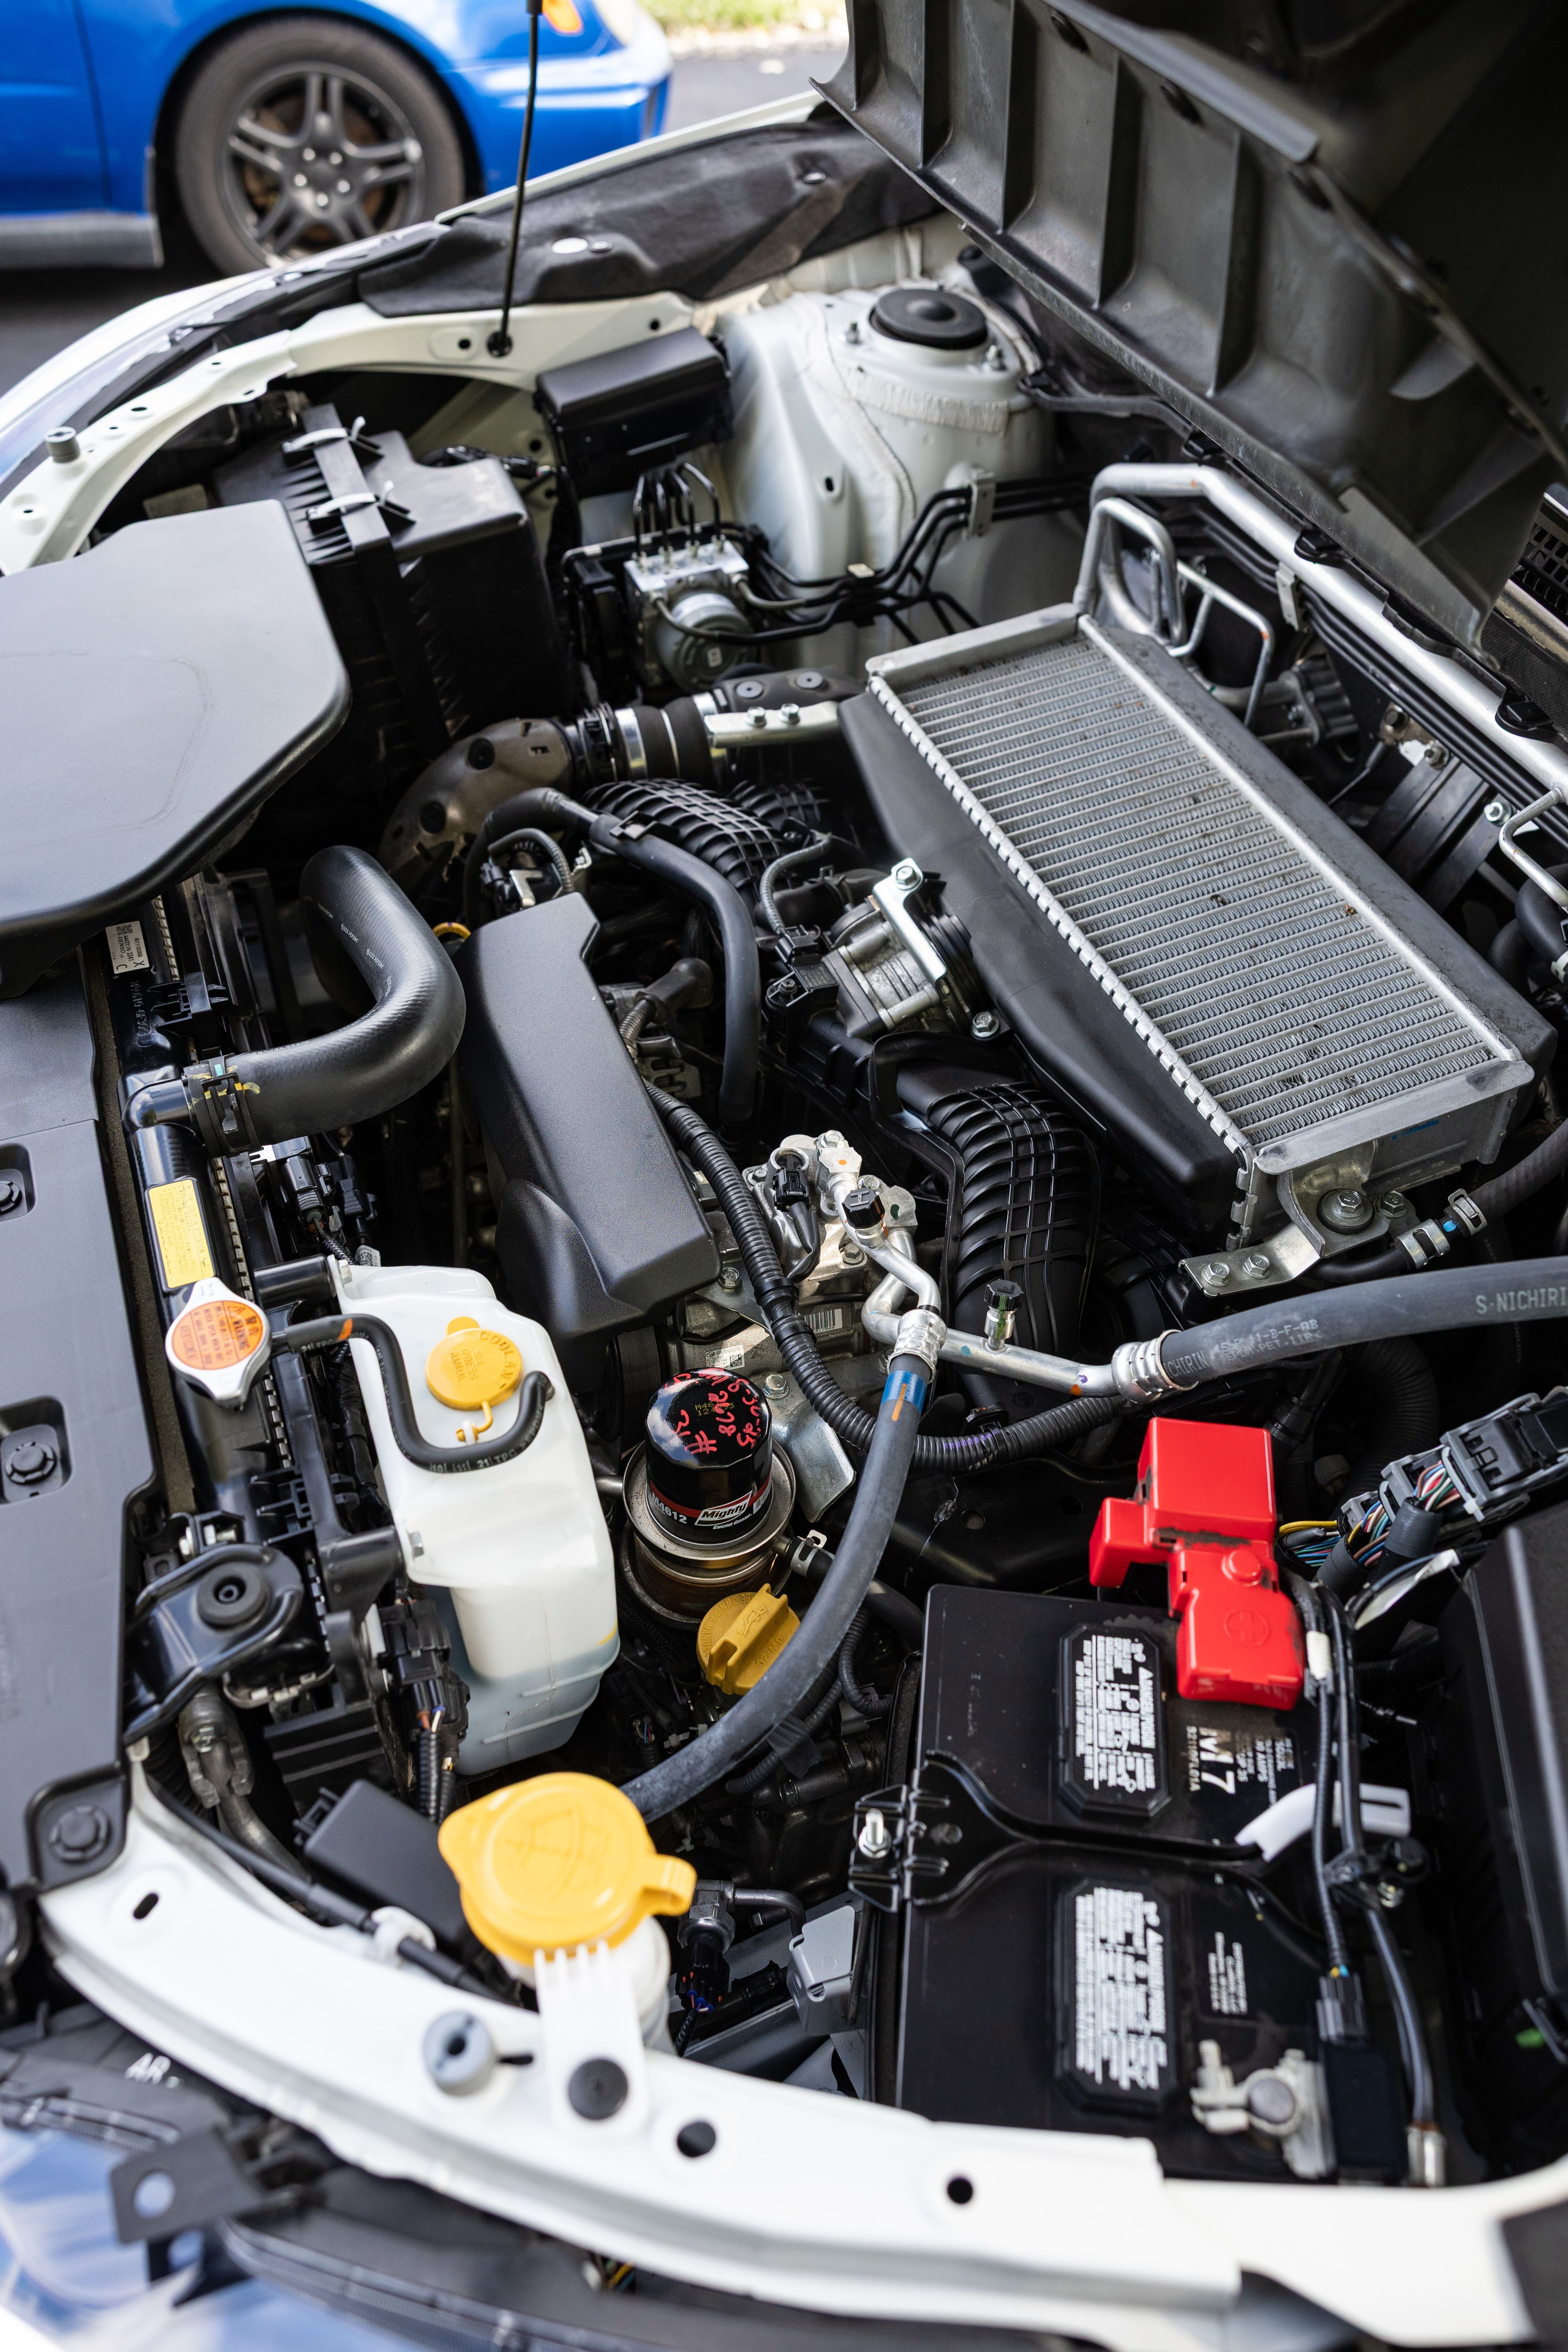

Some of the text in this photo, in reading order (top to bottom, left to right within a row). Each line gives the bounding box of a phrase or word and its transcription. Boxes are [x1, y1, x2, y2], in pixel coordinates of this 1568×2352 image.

[479, 1331, 517, 1389] COOLANT
[652, 1492, 687, 1524] M4612
[701, 1502, 747, 1519] Mighty
